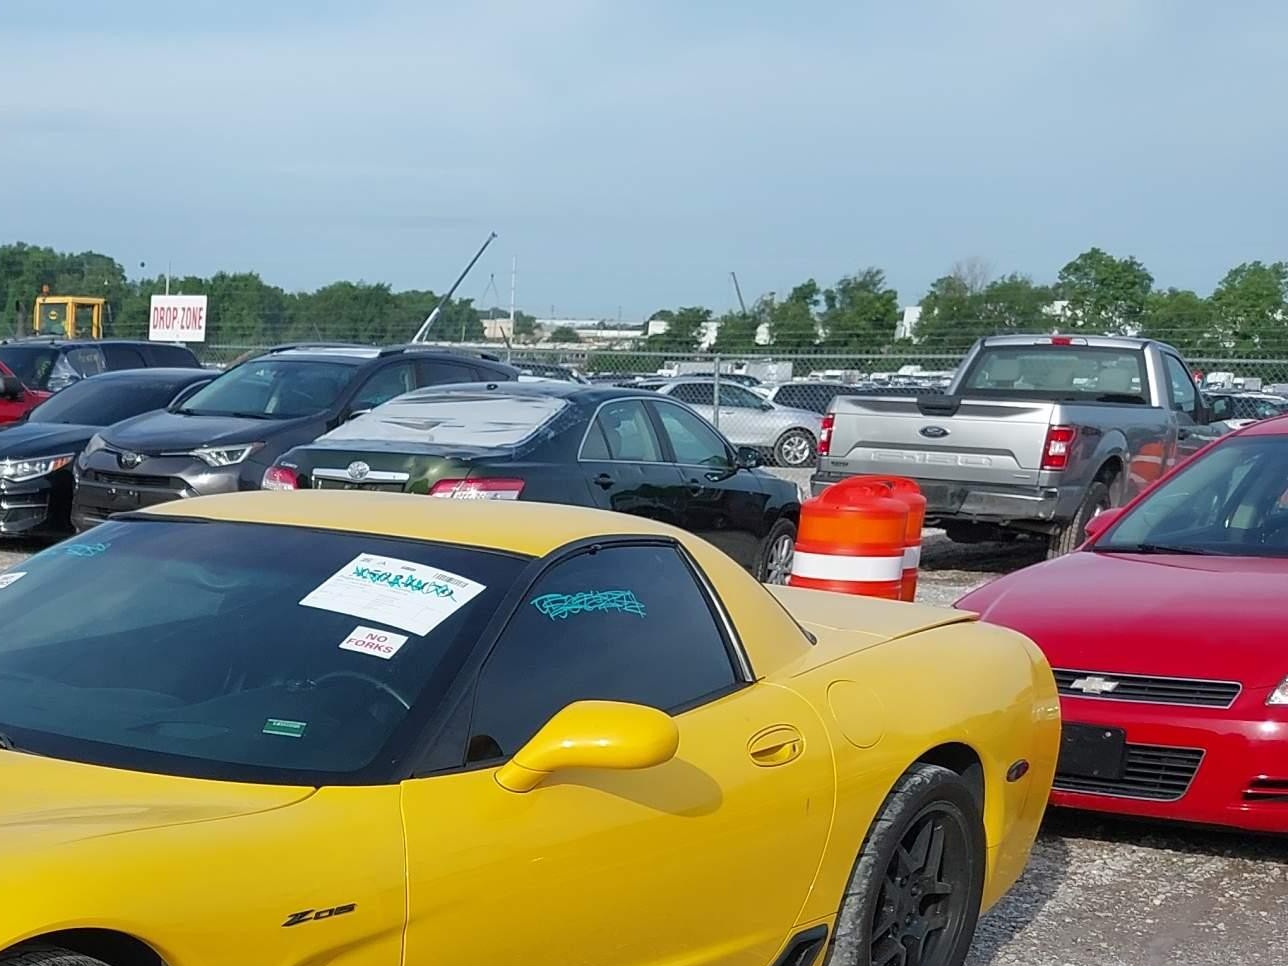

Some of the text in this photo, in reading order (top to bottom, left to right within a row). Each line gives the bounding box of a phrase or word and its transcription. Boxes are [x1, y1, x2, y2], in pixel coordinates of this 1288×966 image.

[152, 306, 204, 330] DROP ZONE
[345, 637, 394, 654] FORKS
[365, 632, 389, 644] NO
